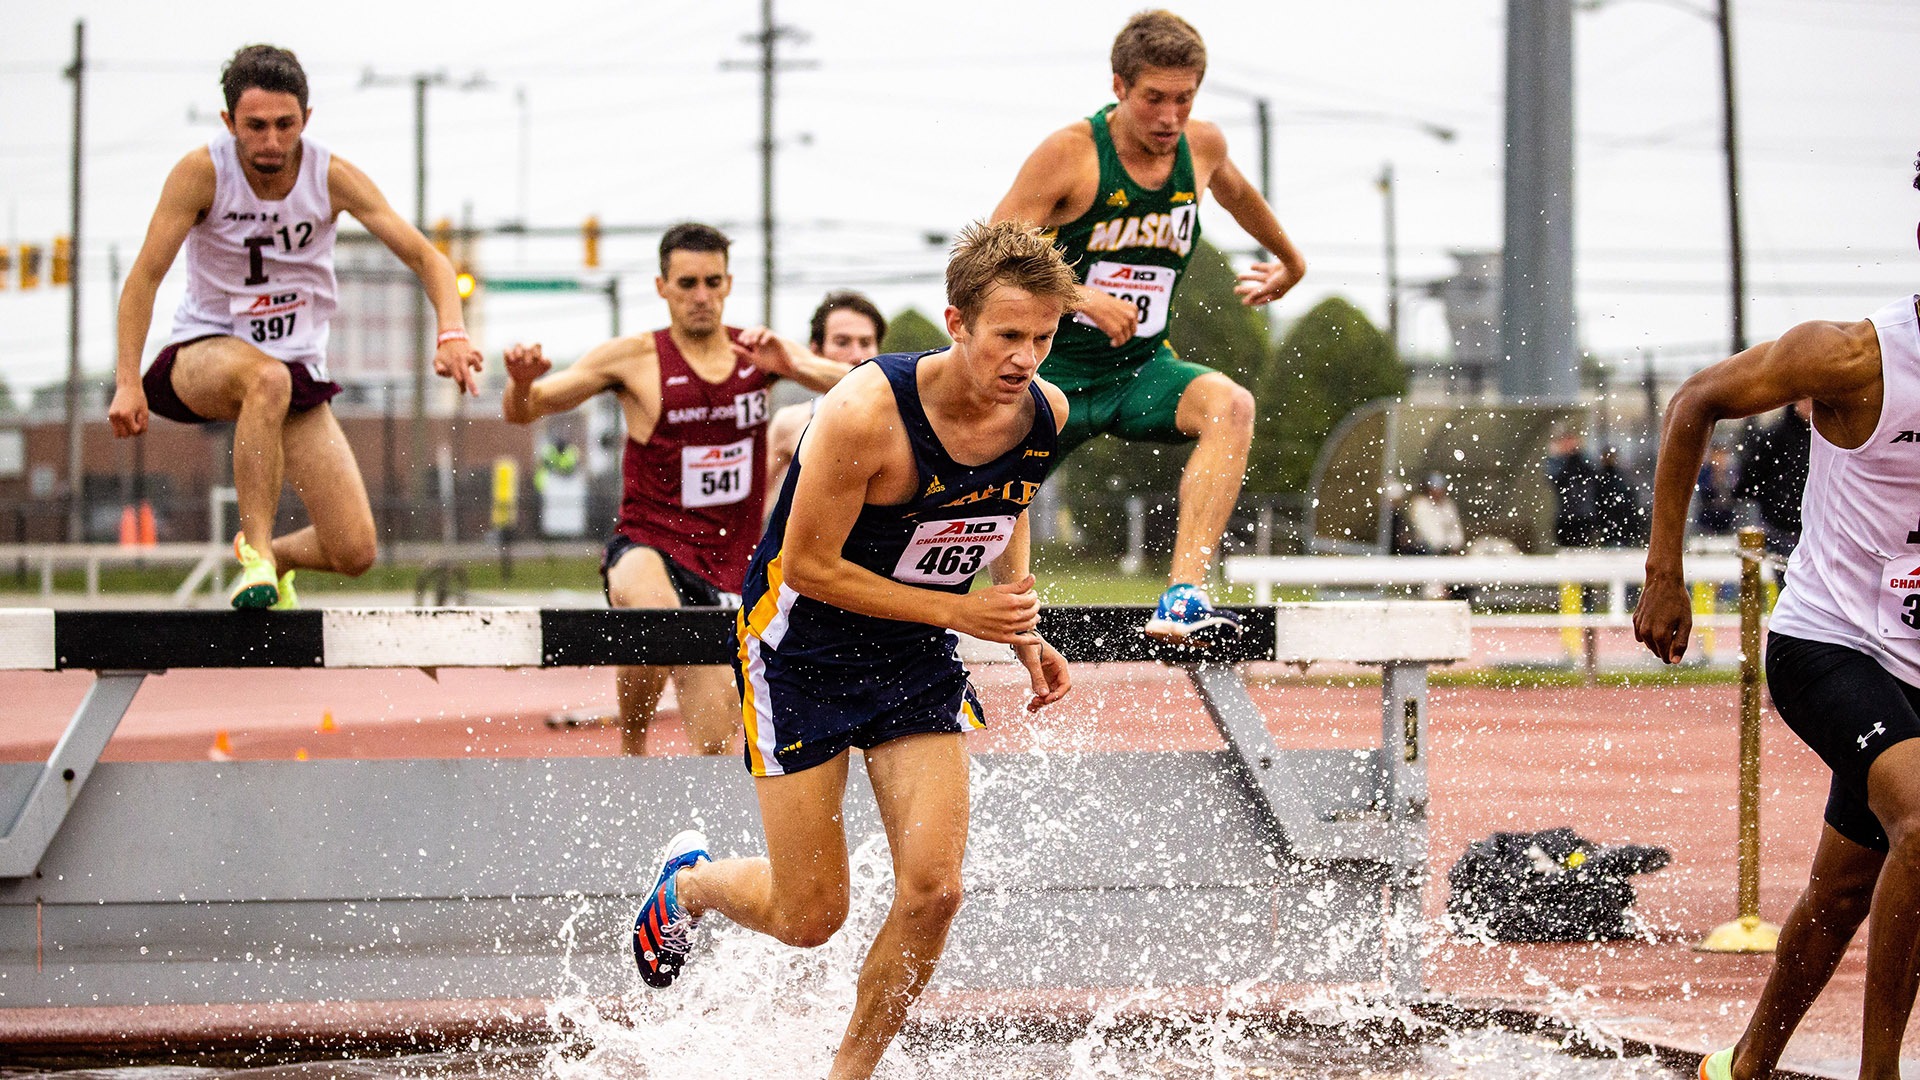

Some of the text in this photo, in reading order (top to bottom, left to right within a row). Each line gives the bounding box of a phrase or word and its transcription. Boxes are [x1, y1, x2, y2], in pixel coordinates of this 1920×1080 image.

[276, 222, 313, 251] 12
[1109, 267, 1157, 280] A10
[249, 293, 297, 310] A10
[250, 313, 296, 342] 397
[667, 406, 708, 424] SAINT
[741, 392, 766, 423] 13
[1022, 450, 1050, 459] A10
[702, 470, 740, 496] 541
[933, 521, 997, 537] A10
[916, 534, 1004, 545] CHAMPIONSHIPS
[915, 545, 986, 575] 463
